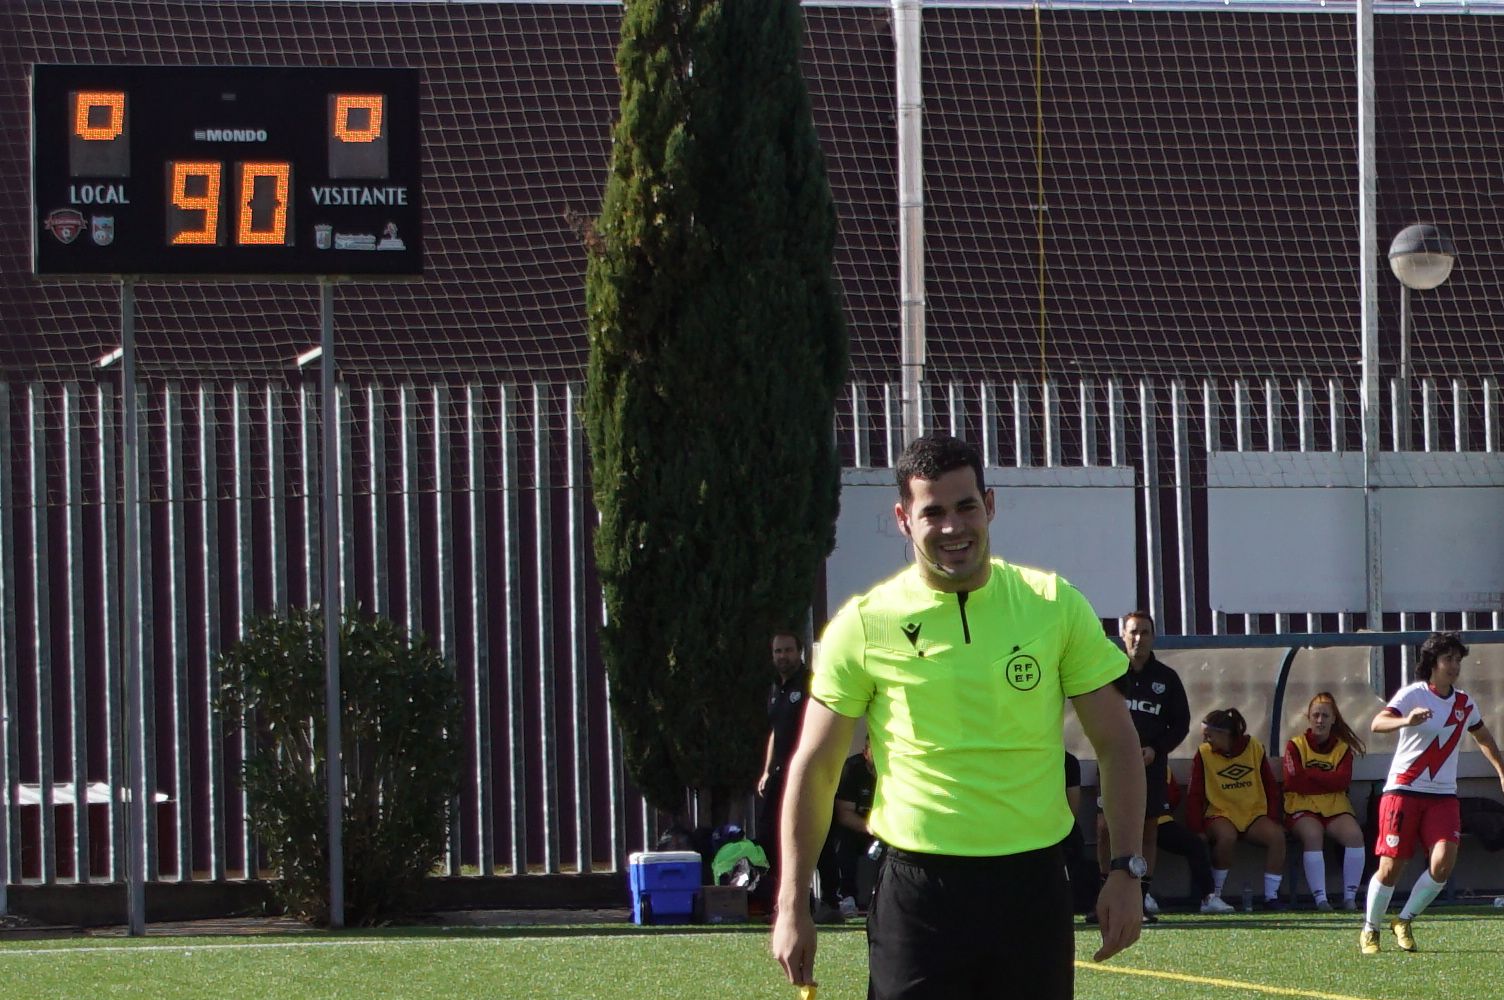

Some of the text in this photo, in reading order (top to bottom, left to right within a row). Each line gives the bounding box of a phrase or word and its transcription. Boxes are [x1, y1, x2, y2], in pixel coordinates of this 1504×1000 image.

[77, 92, 125, 140] 0
[335, 95, 383, 142] 0
[207, 129, 268, 142] MONDO
[70, 185, 130, 204] LOCAL
[173, 162, 290, 244] 90
[311, 186, 408, 206] VISITANTE
[1221, 781, 1252, 789] umbro
